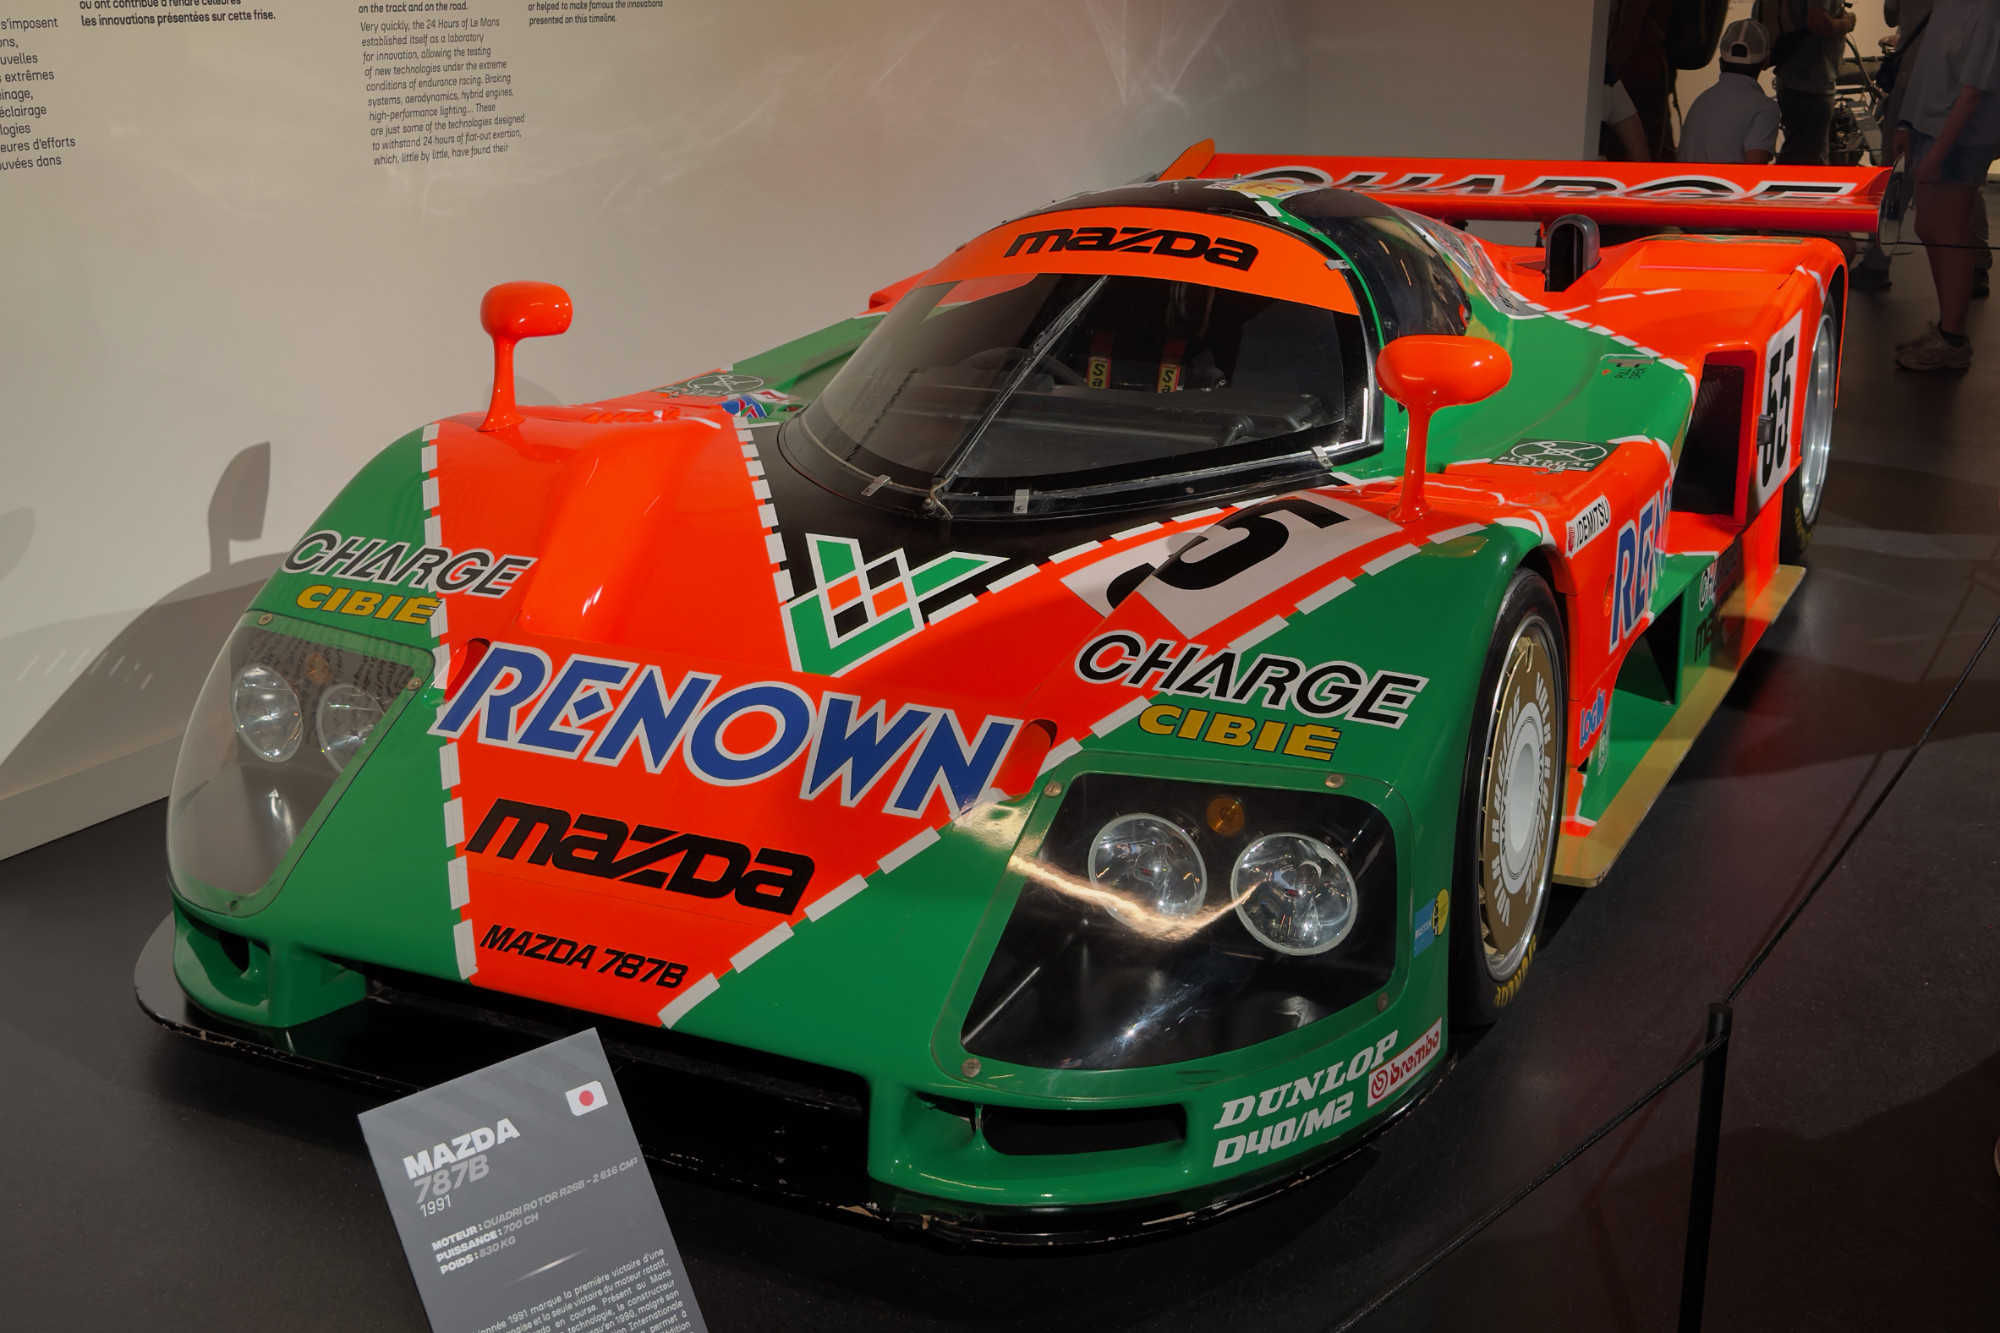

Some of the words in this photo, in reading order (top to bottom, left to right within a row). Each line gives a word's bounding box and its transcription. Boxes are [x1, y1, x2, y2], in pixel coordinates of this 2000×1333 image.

[80, 1, 91, 10] ou
[358, 5, 368, 13] on
[371, 4, 383, 13] the
[386, 4, 406, 12] track
[409, 2, 423, 11] and
[425, 3, 434, 11] on
[436, 2, 448, 11] the
[450, 1, 468, 11] road.
[537, 2, 559, 13] helped
[562, 2, 568, 10] to
[570, 1, 587, 10] make
[588, 0, 613, 12] famous
[1, 18, 58, 32] s'imposent
[81, 15, 97, 26] les
[98, 12, 155, 25] innovations
[157, 11, 210, 26] présentées
[211, 13, 226, 21] sur
[228, 11, 252, 21] cette
[254, 9, 276, 20] frise.
[360, 22, 378, 33] Very
[381, 20, 410, 32] quickly,
[412, 20, 424, 30] the
[427, 20, 436, 29] 24
[438, 18, 459, 29] Hours
[461, 17, 469, 30] of
[471, 18, 479, 27] Le
[480, 17, 500, 27] Mans
[529, 16, 563, 27] presented
[575, 14, 587, 23] this
[362, 35, 407, 47] established
[410, 34, 428, 46] itself
[430, 36, 439, 44] as
[448, 33, 484, 44] laboratory
[363, 52, 374, 64] for
[376, 50, 419, 61] innovation,
[421, 48, 451, 60] allowing
[454, 48, 465, 57] the
[467, 47, 491, 58] testing
[5, 69, 54, 82] extrêmes
[365, 67, 372, 79] of
[375, 67, 391, 76] new
[393, 64, 441, 76] technologies
[443, 62, 464, 72] under
[466, 61, 478, 70] the
[479, 60, 507, 69] extreme
[366, 79, 407, 91] conditions
[409, 79, 417, 90] of
[419, 77, 457, 88] endurance
[459, 75, 482, 86] racing.
[485, 73, 511, 85] Braking
[368, 96, 403, 107] systems,
[405, 92, 459, 106] aerodynamics,
[461, 89, 483, 99] hybrid
[486, 88, 513, 99] engines,
[369, 108, 437, 123] high-performance
[476, 103, 496, 112] These
[371, 127, 383, 136] are
[385, 125, 400, 137] just
[402, 125, 423, 133] some
[426, 121, 432, 133] of
[435, 120, 446, 130] the
[448, 117, 492, 129] technologies
[494, 113, 524, 126] designed
[33, 137, 76, 150] d'efforts
[373, 141, 380, 151] to
[382, 138, 420, 150] withstand
[423, 136, 432, 146] 24
[435, 135, 454, 145] hours
[457, 133, 464, 145] of
[465, 130, 491, 144] flat-out
[493, 128, 522, 139] exertion,
[37, 155, 62, 167] dans
[374, 154, 399, 165] which,
[402, 152, 419, 163] little
[421, 151, 430, 162] by
[432, 149, 450, 160] little,
[452, 148, 469, 158] have
[471, 145, 490, 158] found
[493, 143, 509, 152] their
[1003, 226, 1259, 272] mazda
[1576, 499, 1609, 548] IDEMITSU
[283, 531, 536, 598] CHARGE
[1075, 630, 1428, 729] CHARGE
[1579, 688, 1606, 749] LOGIN
[426, 641, 1023, 826] RENOWN
[466, 798, 815, 916] mazda
[480, 925, 600, 969] MAZDA
[599, 948, 688, 988] 787B
[1389, 1030, 1439, 1086] brembo
[1213, 1029, 1398, 1130] DUNLOP
[1212, 1091, 1354, 1168] D40/M2
[403, 1118, 520, 1180] MAZDA
[412, 1154, 490, 1204] 787B
[419, 1195, 452, 1217] 1991
[483, 1205, 523, 1230] QUADRI
[523, 1192, 559, 1213] ROTOR
[559, 1179, 586, 1198] R26B
[600, 1165, 618, 1180] 616
[502, 1219, 522, 1235] 700
[523, 1212, 539, 1226] CH
[479, 1242, 500, 1258] 830
[500, 1235, 516, 1251] KG
[508, 1309, 528, 1324] 1991
[530, 1296, 562, 1314] marque
[563, 1290, 572, 1299] la
[611, 1259, 641, 1278] victoire
[643, 1248, 664, 1263] d'une
[542, 1313, 551, 1321] la
[551, 1302, 573, 1317] seule
[573, 1290, 603, 1307] victoire
[614, 1270, 641, 1288] moteur
[642, 1257, 668, 1275] rotatif,
[627, 1280, 675, 1307] constructeur
[555, 1318, 566, 1328] en
[570, 1304, 599, 1321] course.
[650, 1269, 672, 1284] Mans
[615, 1309, 638, 1324] 1990,
[665, 1290, 680, 1301] son
[628, 1300, 683, 1331] Internationale
